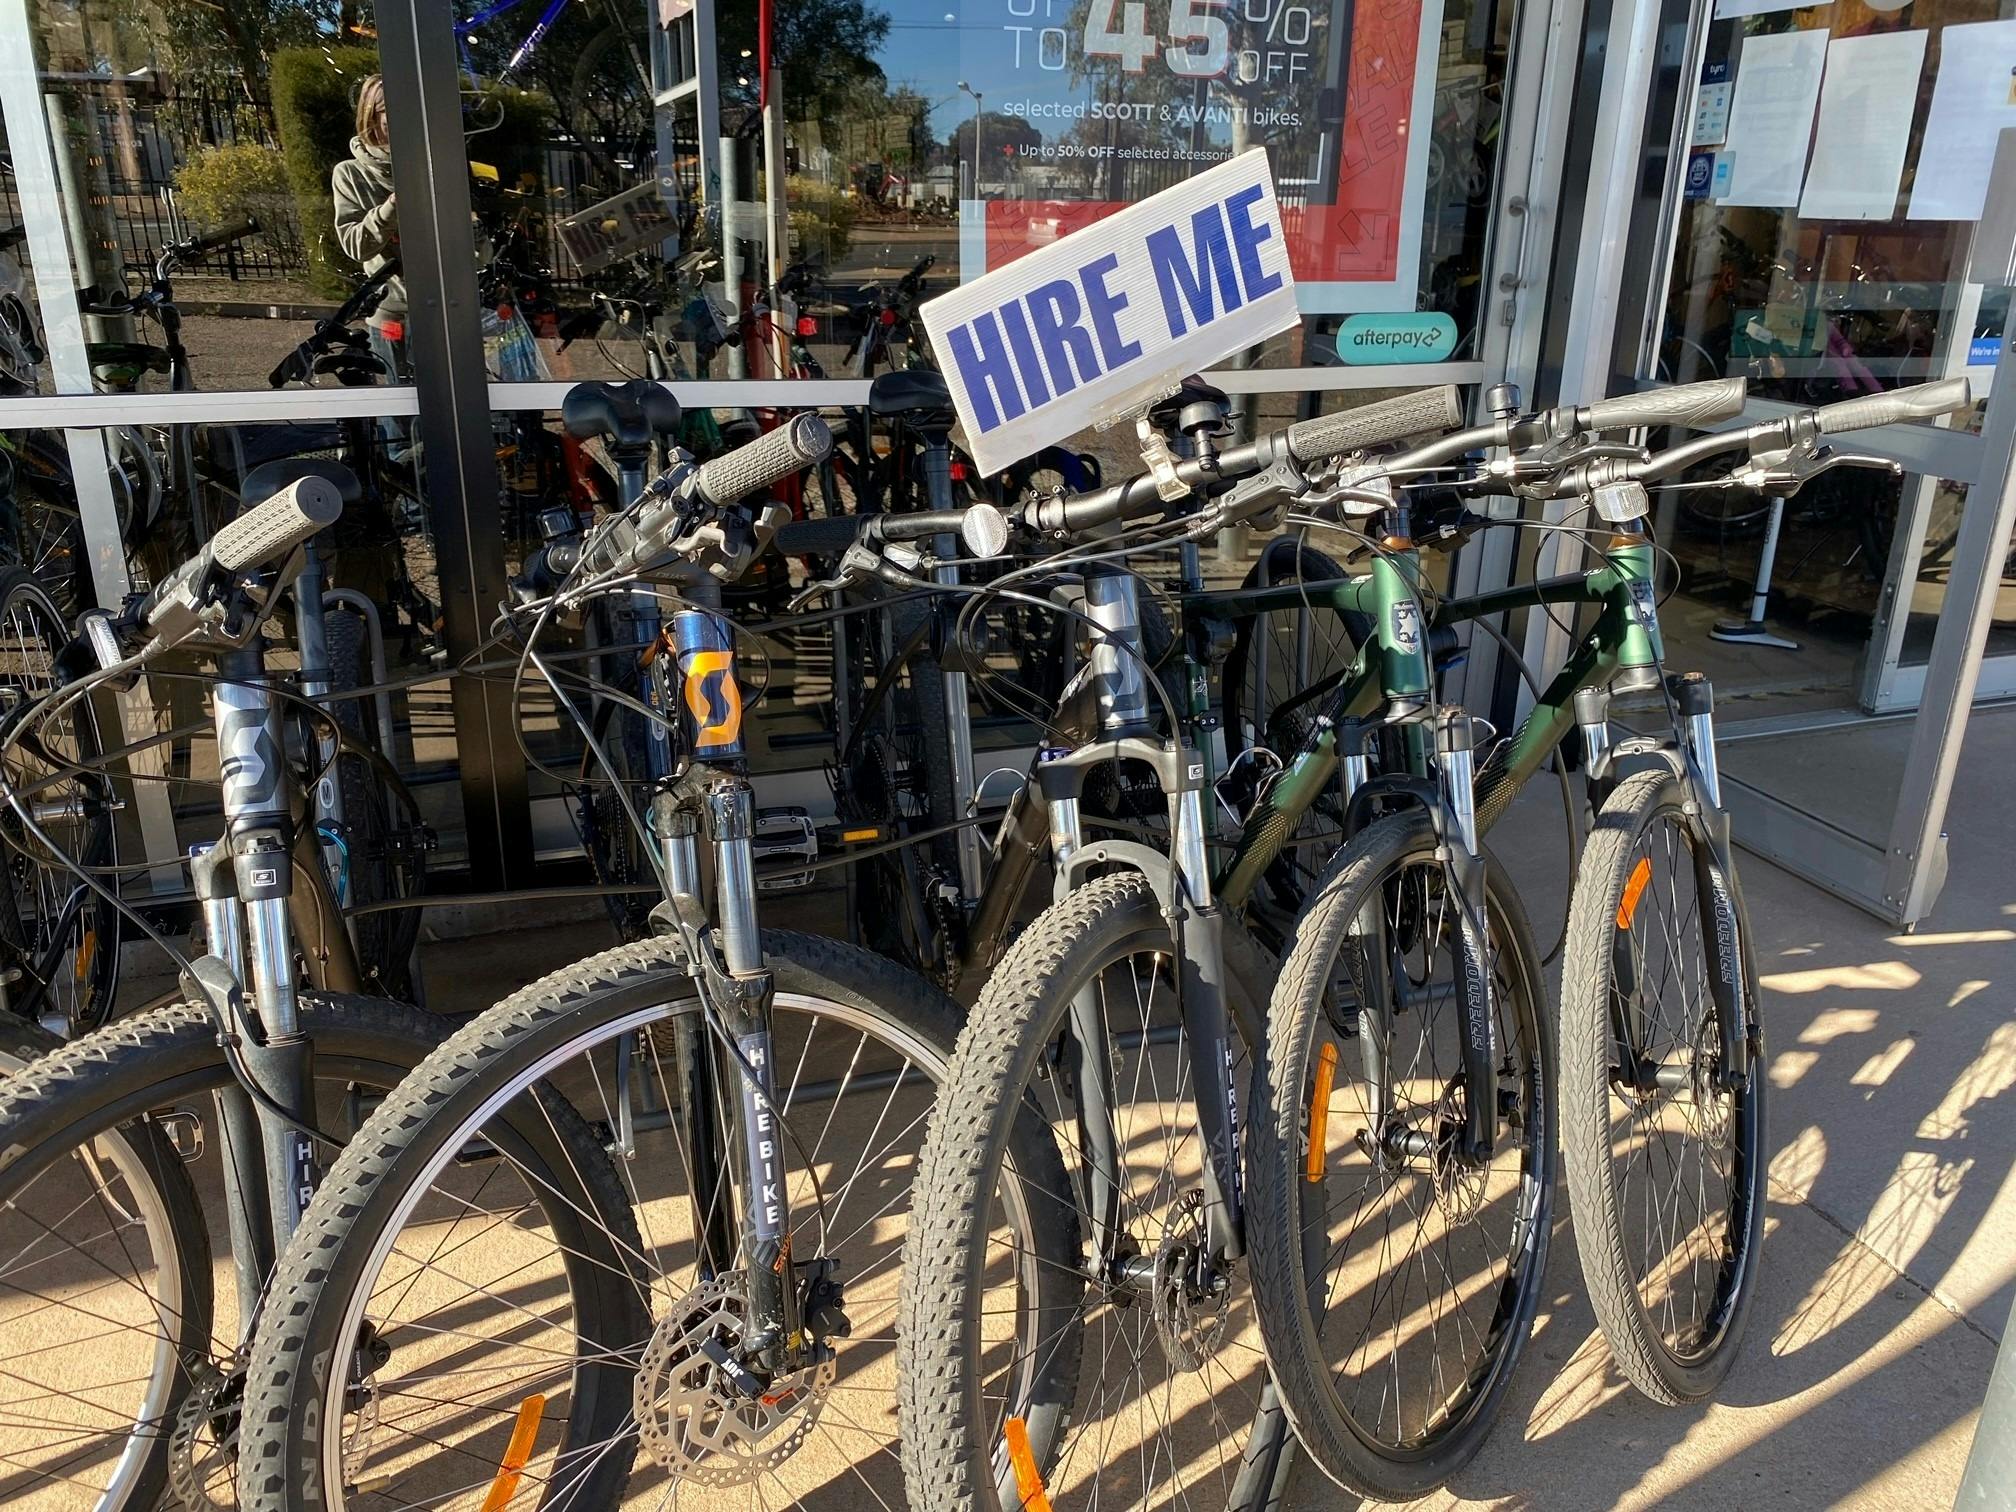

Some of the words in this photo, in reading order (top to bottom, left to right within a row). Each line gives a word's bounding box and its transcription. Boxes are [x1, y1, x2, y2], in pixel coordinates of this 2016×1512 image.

[1003, 25, 1068, 71] TO
[1083, 0, 1231, 79] 45
[1239, 50, 1309, 84] OFF
[1003, 98, 1085, 119] selected
[1090, 102, 1155, 121] SCOTT
[1159, 105, 1171, 121] &
[1176, 105, 1248, 124] AVANTI
[1253, 107, 1303, 127] bikes.
[1019, 143, 1038, 160] Up
[1040, 145, 1055, 158] to
[1057, 145, 1085, 158] 50%
[1088, 146, 1115, 159] OFF
[1117, 146, 1170, 161] selected
[946, 252, 1143, 434] HIRE
[1145, 183, 1283, 340] ME
[1353, 328, 1423, 349] afterpay
[1463, 944, 1483, 1051] FREEDOM
[1225, 1049, 1238, 1125] HIRE
[298, 1141, 314, 1206] HIR
[759, 1140, 779, 1225] BIKE
[720, 1358, 745, 1378] JOY
